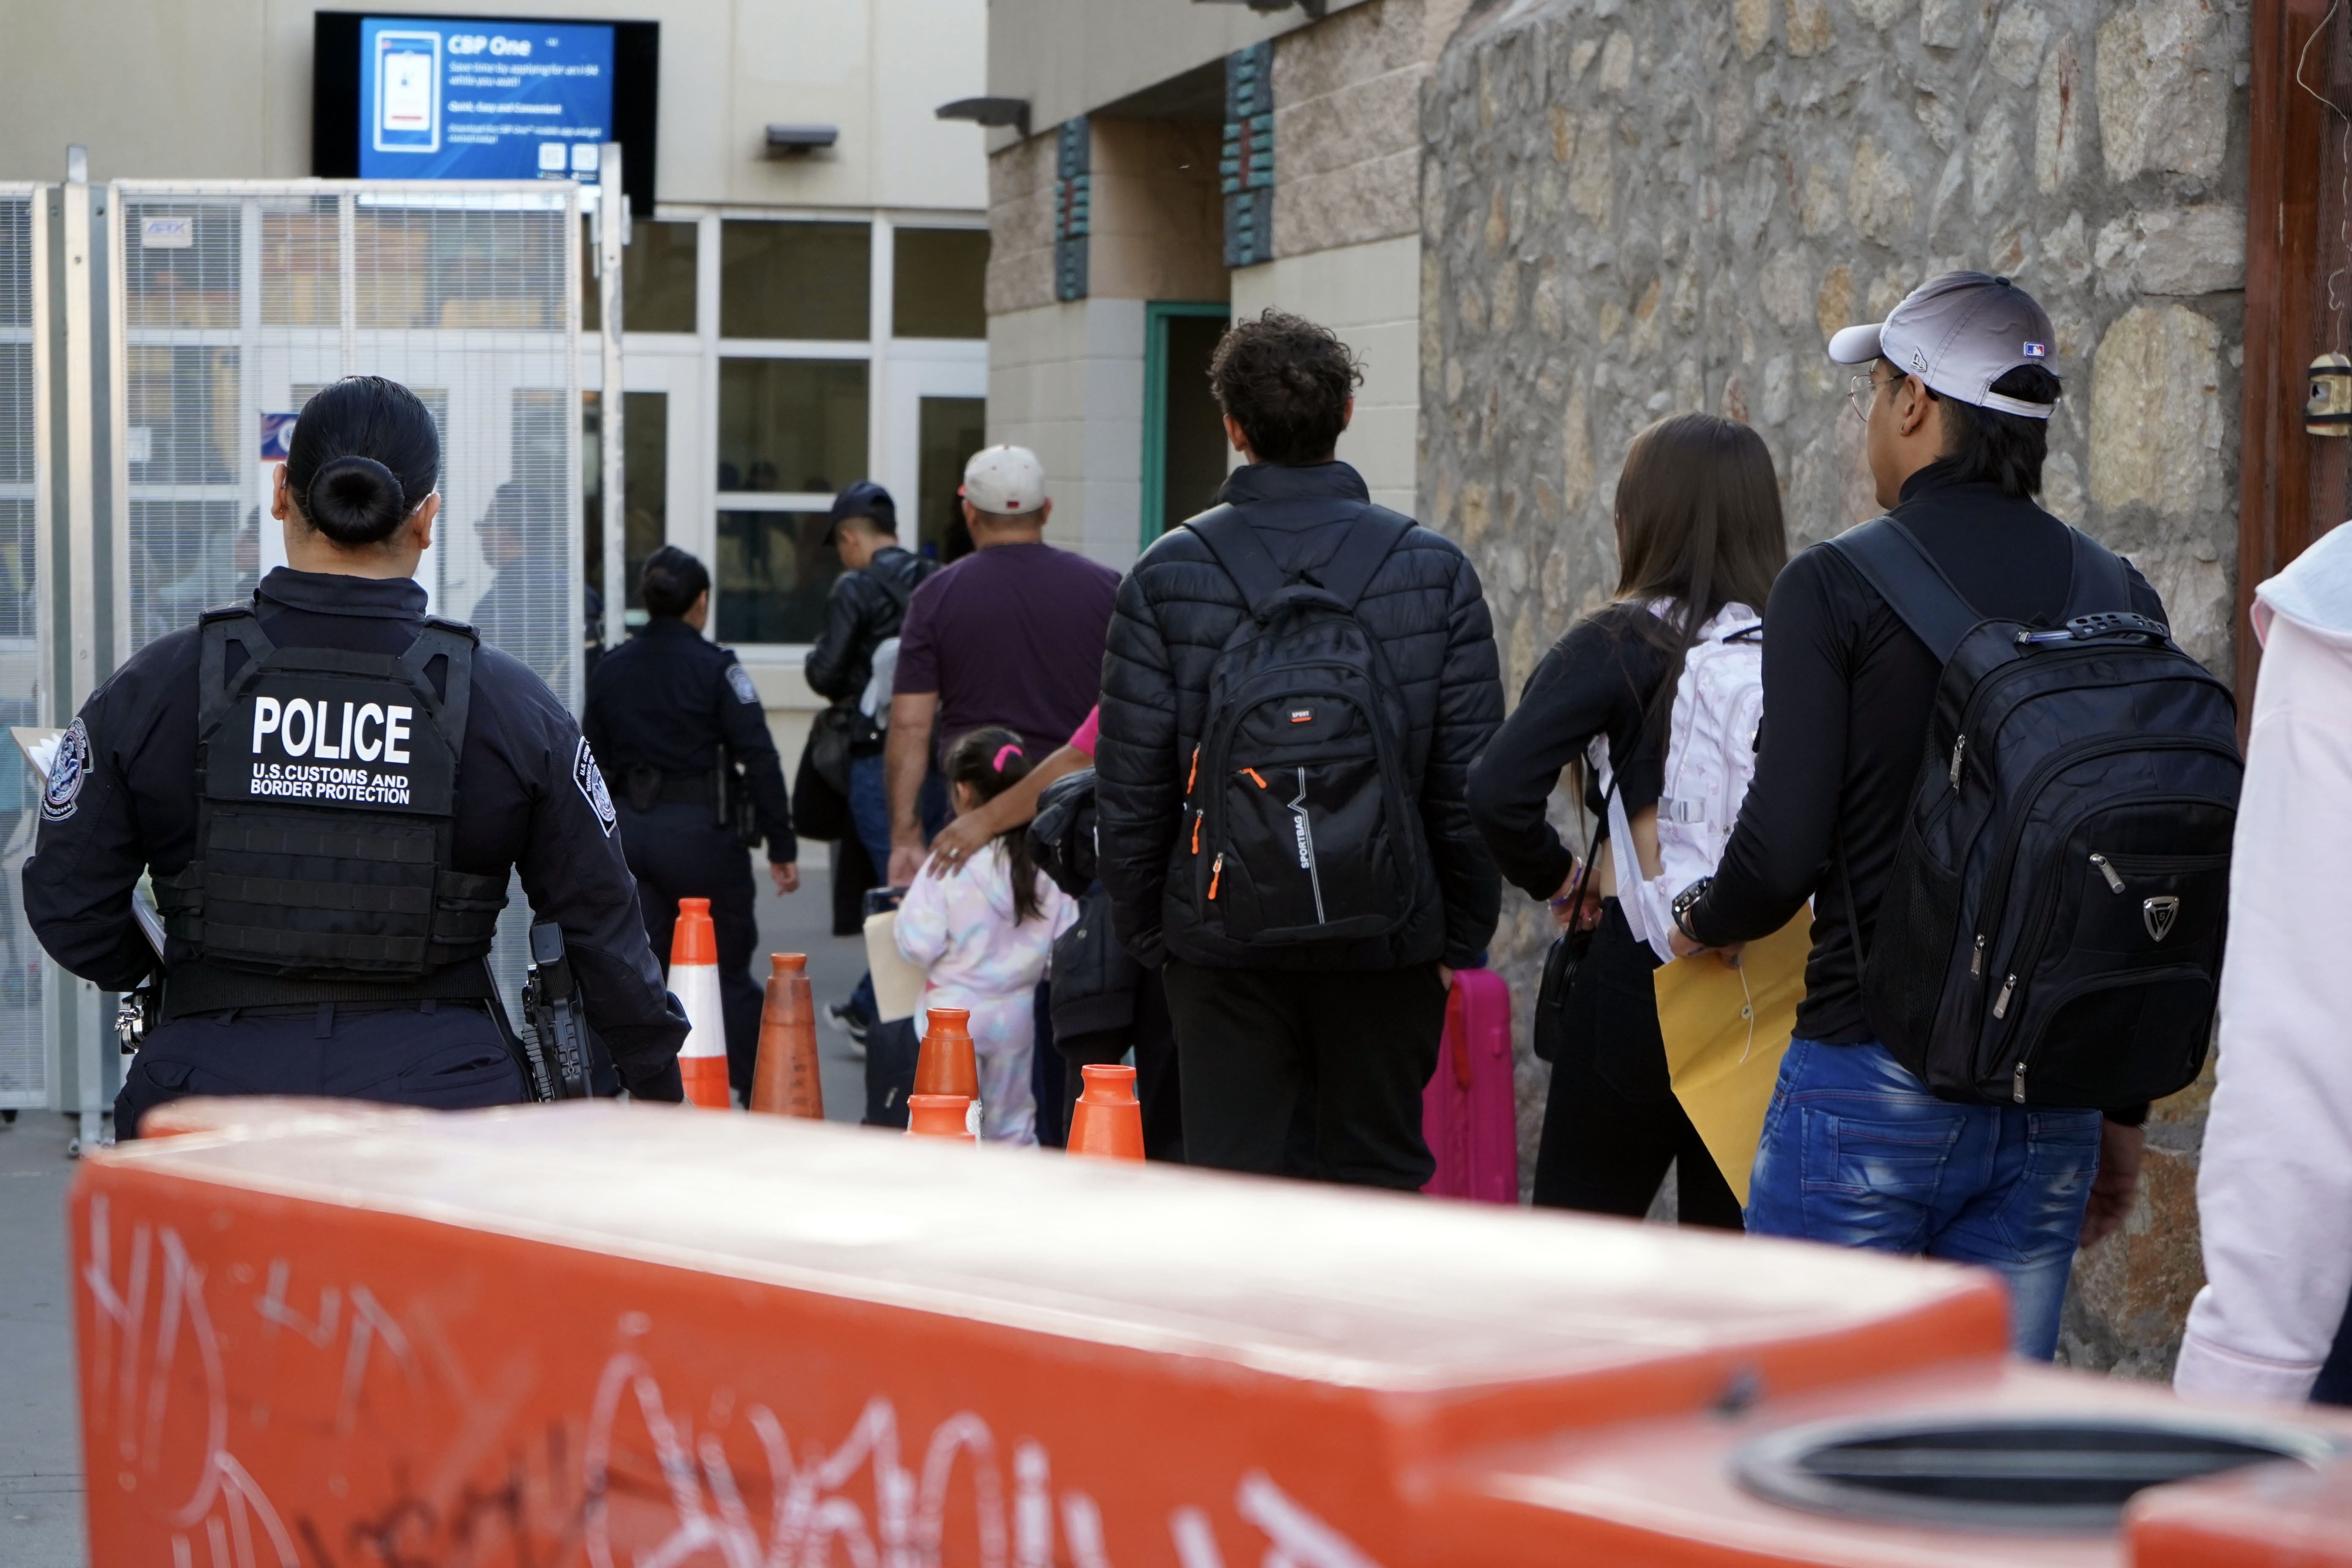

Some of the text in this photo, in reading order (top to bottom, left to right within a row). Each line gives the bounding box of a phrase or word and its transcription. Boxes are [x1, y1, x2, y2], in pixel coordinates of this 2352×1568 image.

[448, 35, 487, 55] CBP
[489, 36, 531, 56] One
[449, 61, 470, 72] Save
[474, 62, 494, 73] time
[495, 62, 508, 75] by
[509, 64, 550, 76] applying
[476, 77, 494, 88] you
[253, 697, 412, 764] POLICE
[371, 774, 408, 788] AND
[251, 779, 409, 805] BORDER PROTECTION
[1294, 816, 1310, 869] SPORTBAG
